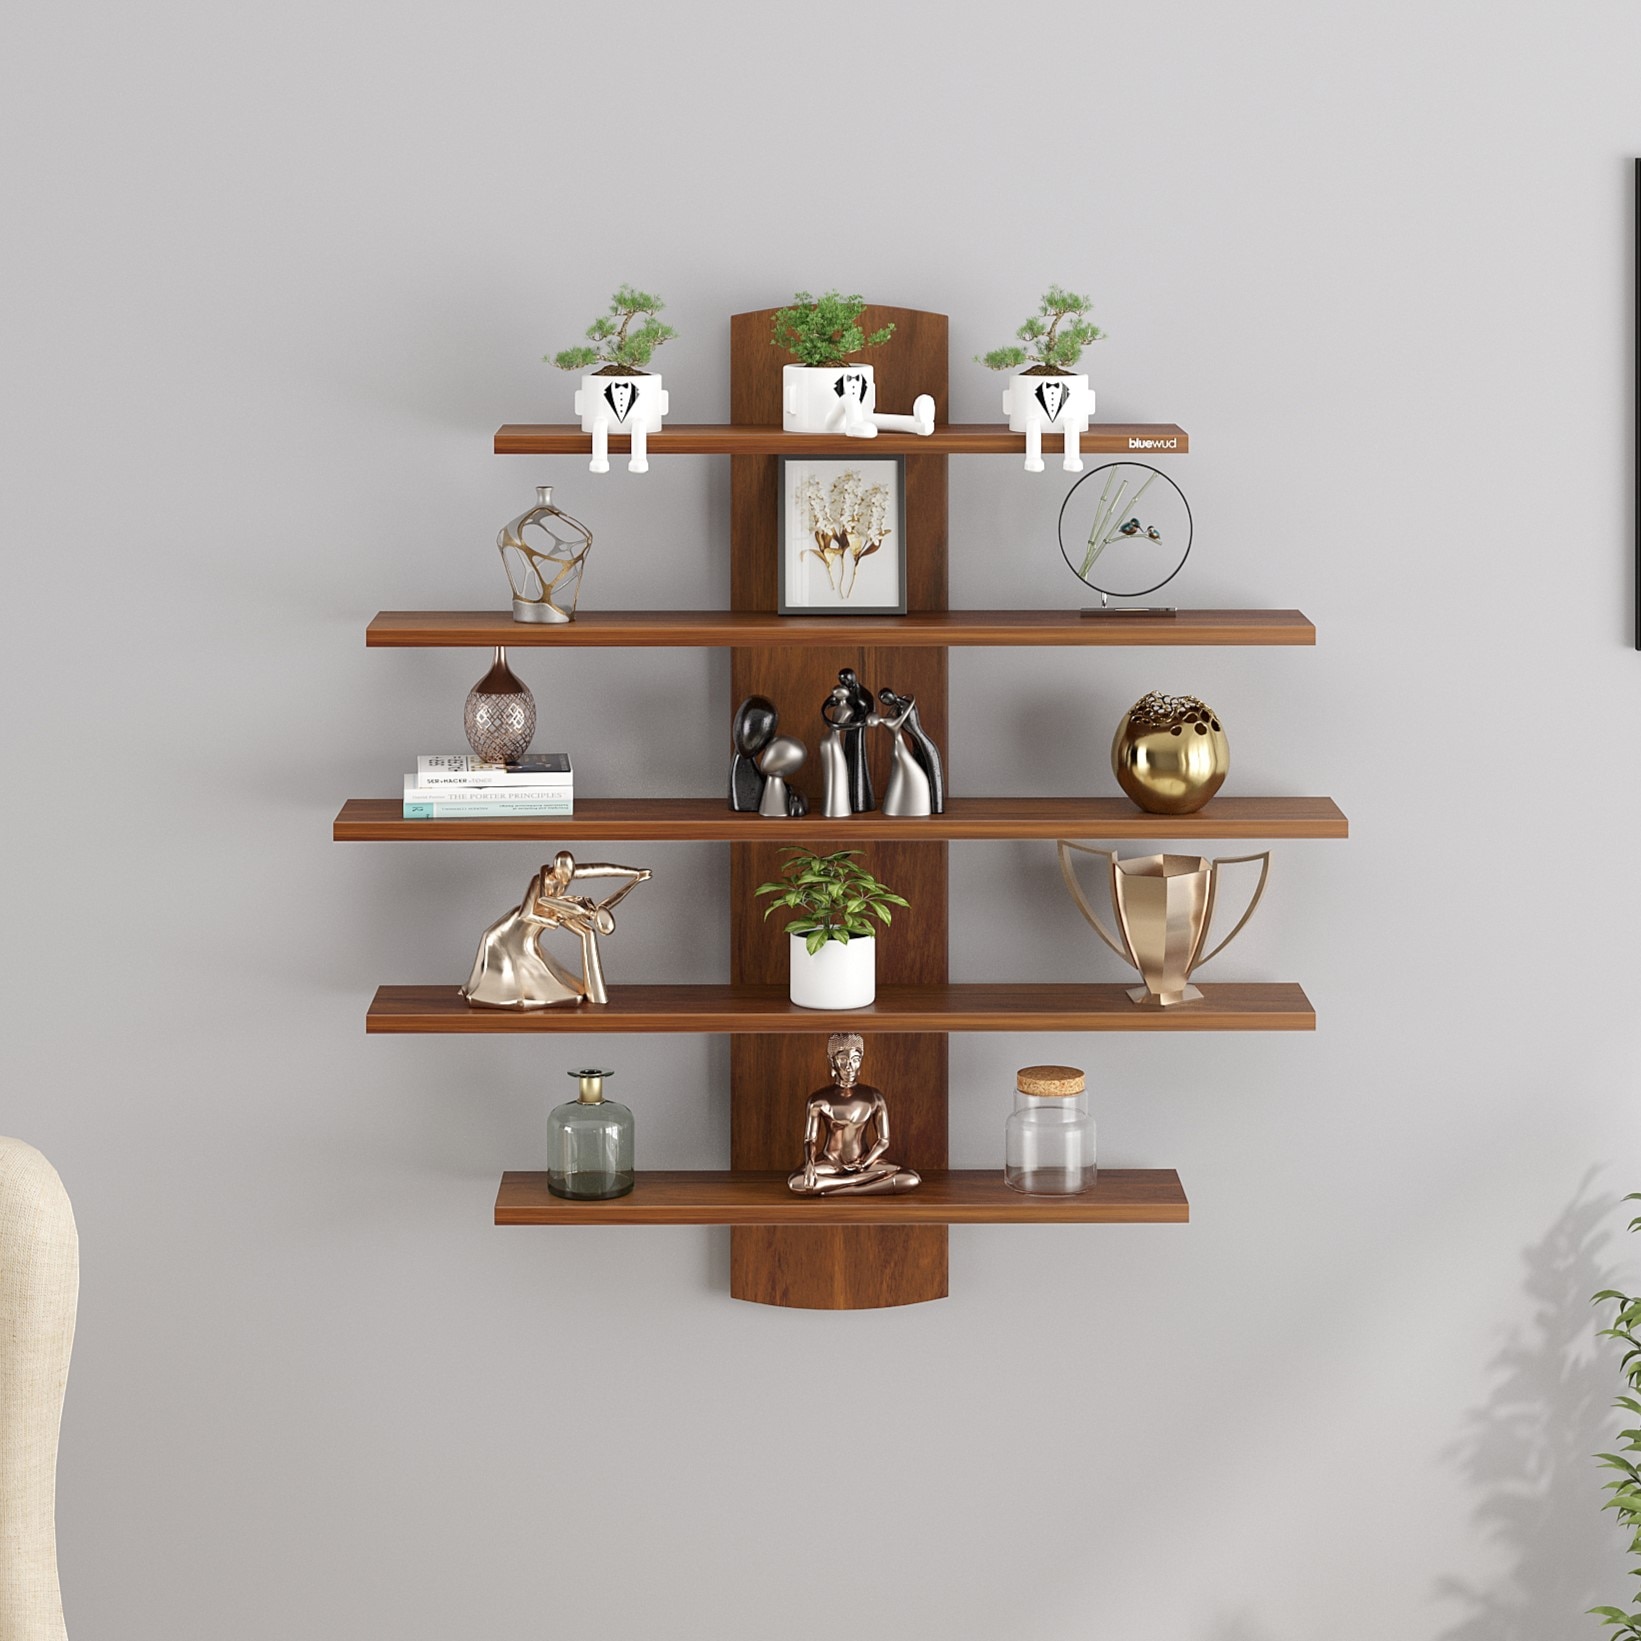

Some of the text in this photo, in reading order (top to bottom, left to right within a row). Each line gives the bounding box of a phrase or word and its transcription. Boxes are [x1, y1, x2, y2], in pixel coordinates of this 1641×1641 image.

[1128, 437, 1177, 449] bluewud
[469, 792, 506, 800] PORTER
[508, 791, 562, 799] PRINCIPLES
